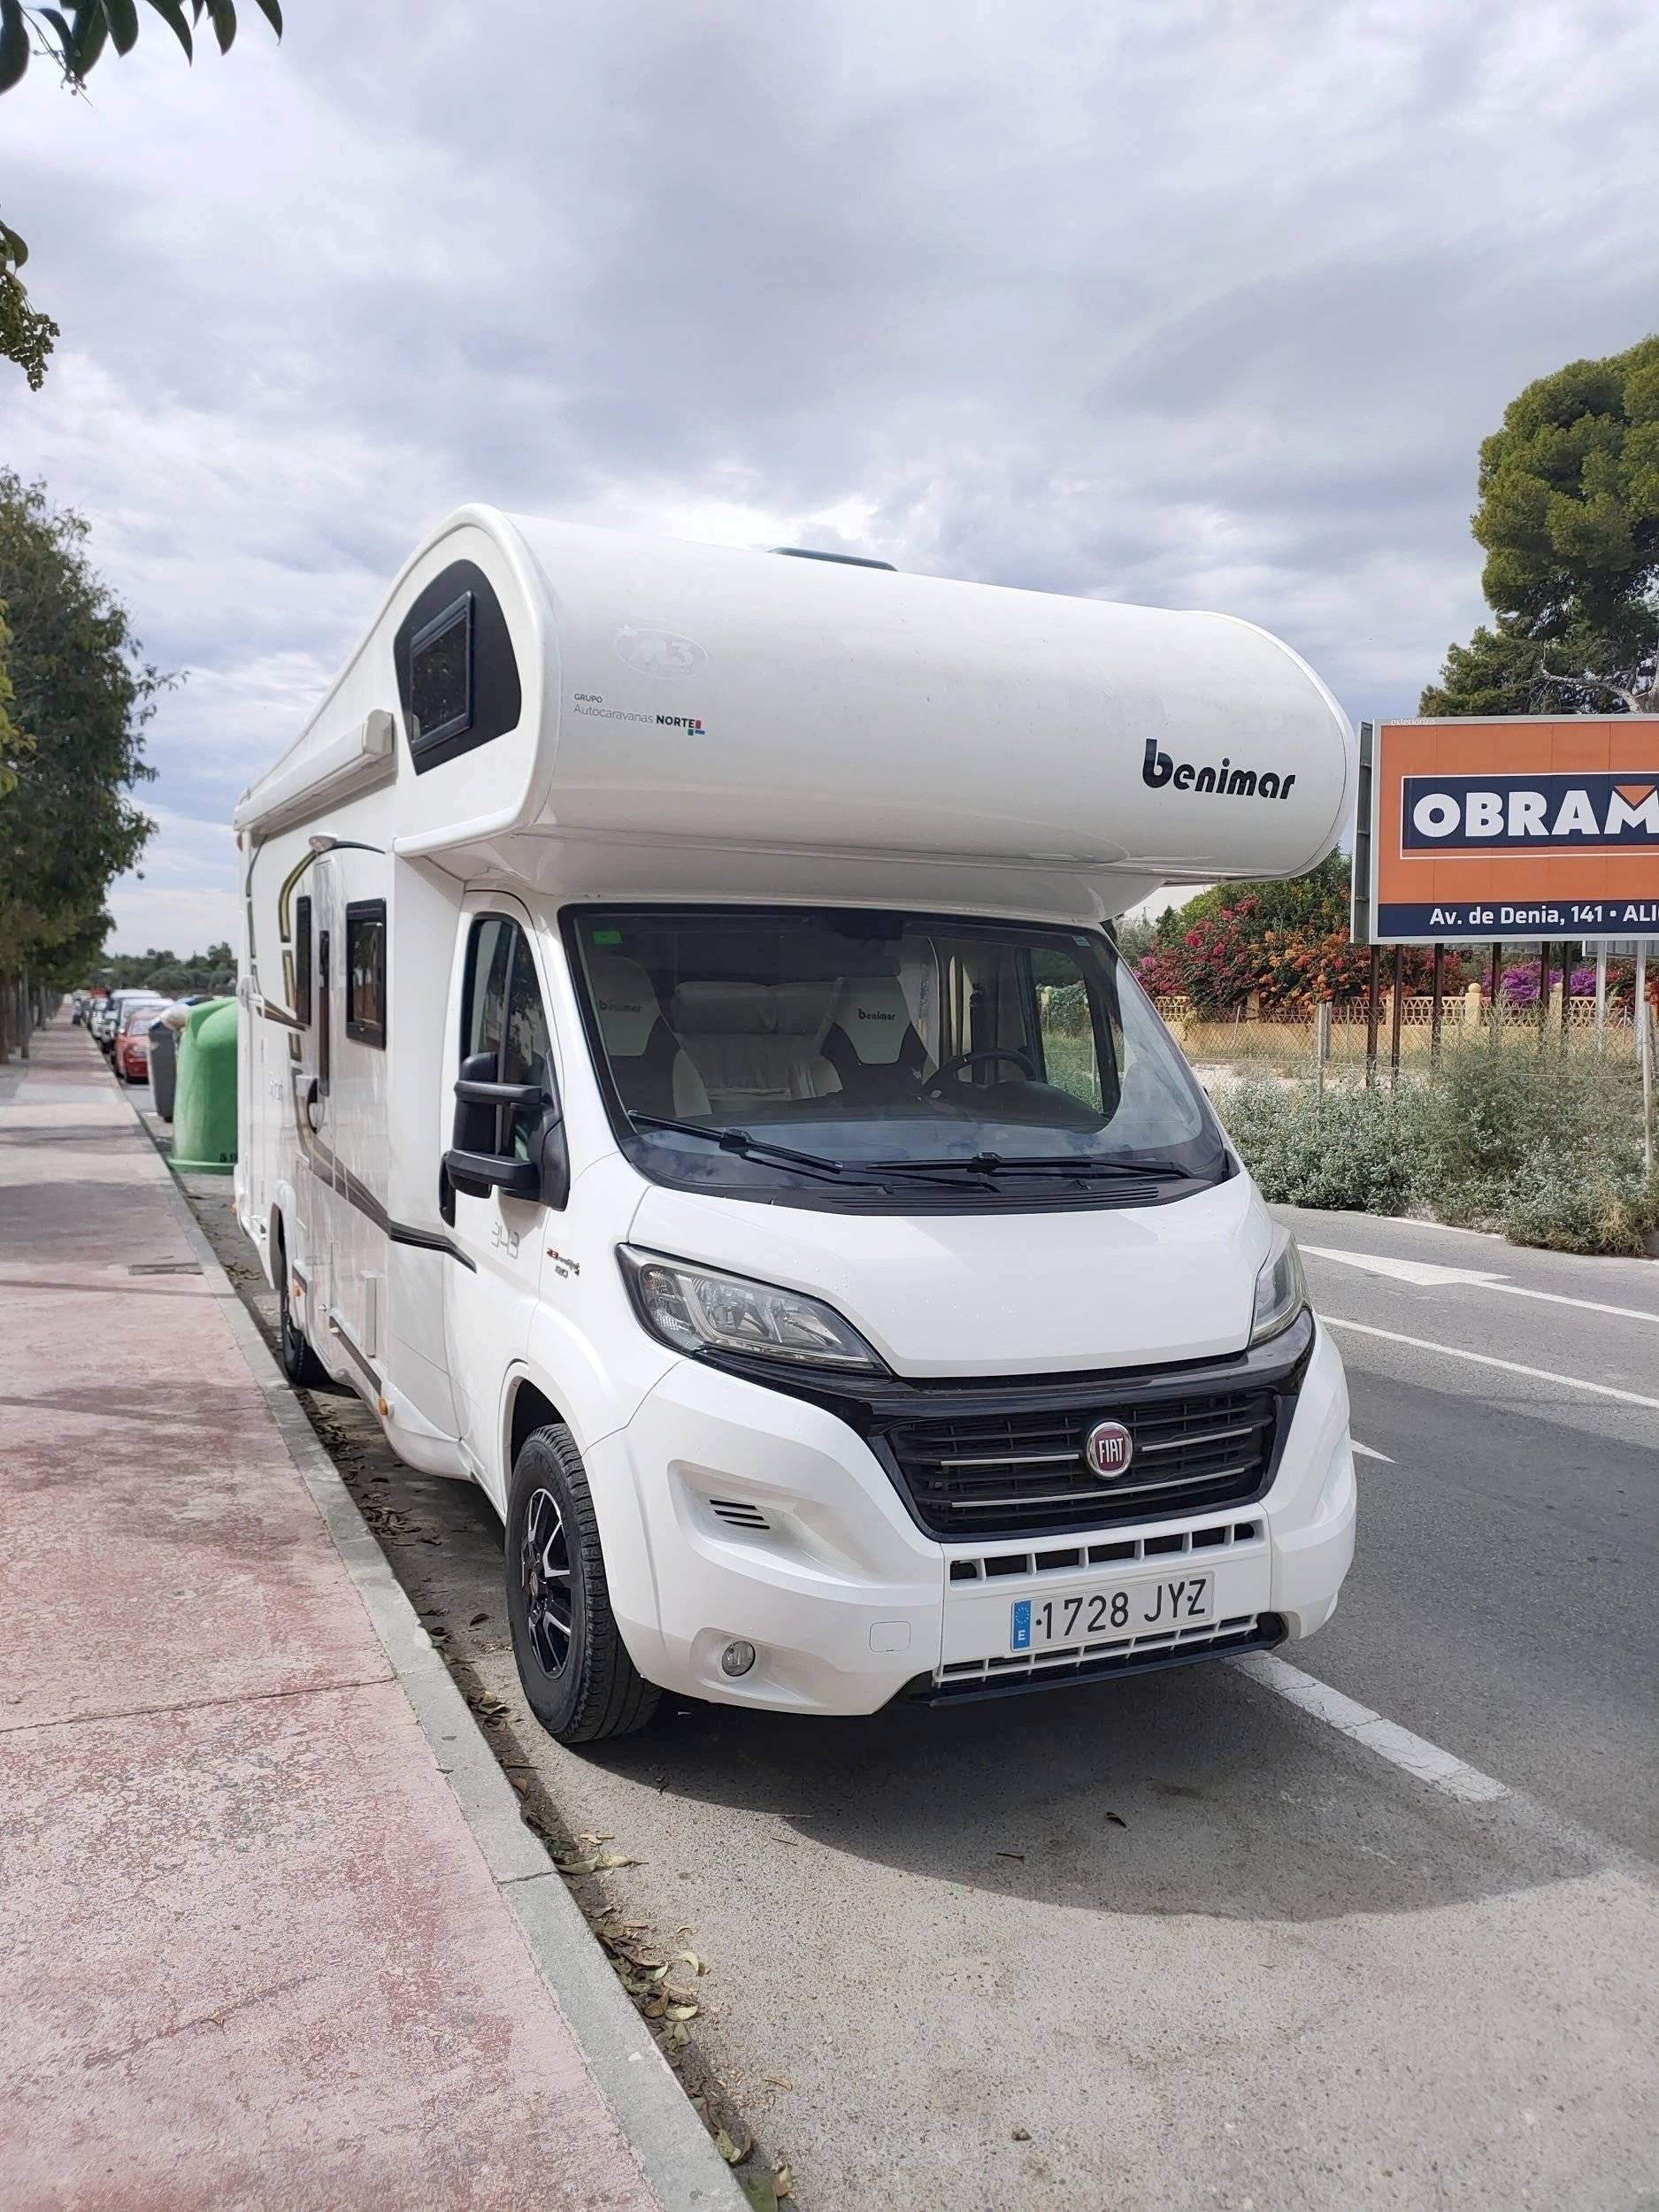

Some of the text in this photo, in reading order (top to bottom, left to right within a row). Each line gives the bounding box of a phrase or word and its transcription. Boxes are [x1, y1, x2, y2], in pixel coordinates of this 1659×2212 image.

[573, 693, 603, 703] GRUPO
[573, 703, 695, 729] Autocaravanas NORTE
[1142, 738, 1295, 800] benimar
[1413, 789, 1659, 838] OBRAM
[1429, 904, 1659, 926] Av. de Denia, 141 ALI
[1098, 1437, 1124, 1463] FIAT
[1018, 1578, 1207, 1641] E 1728 JYZ
